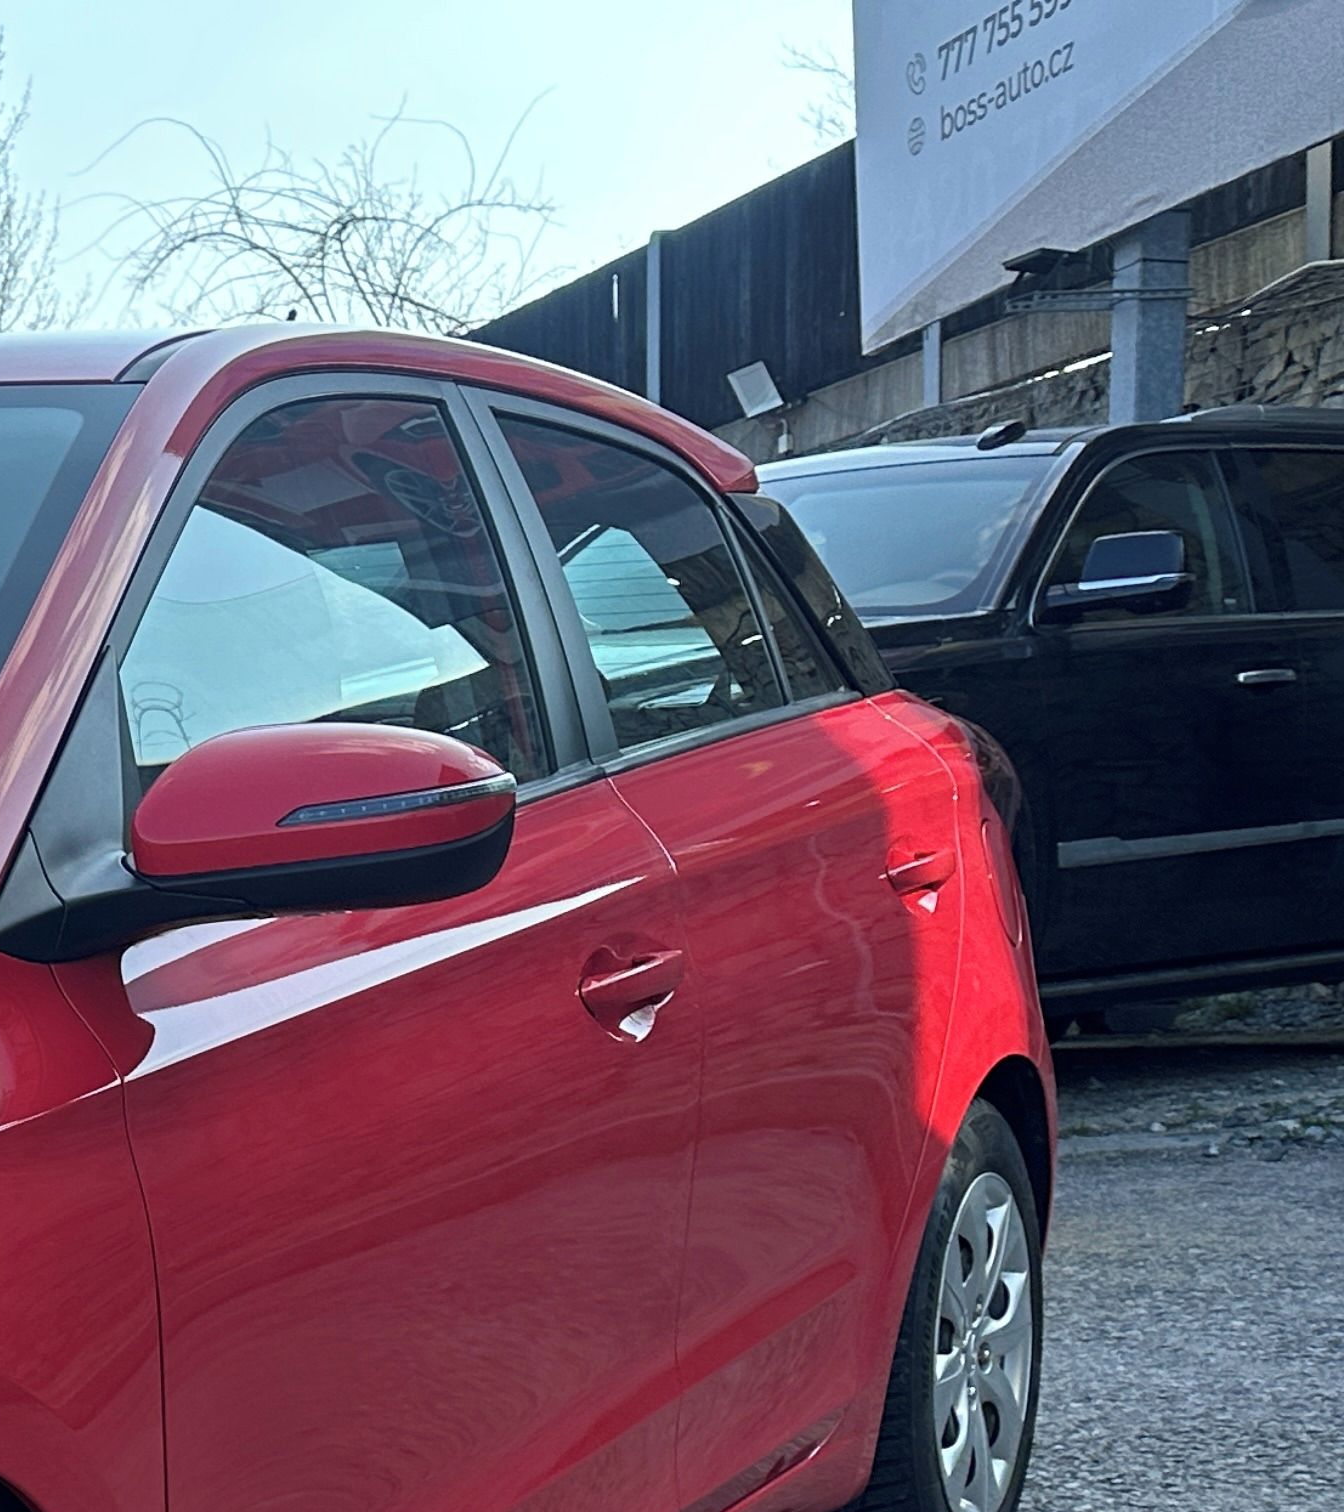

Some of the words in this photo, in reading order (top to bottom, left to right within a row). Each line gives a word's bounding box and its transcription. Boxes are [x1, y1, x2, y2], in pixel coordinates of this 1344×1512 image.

[937, 25, 978, 81] 777
[983, 0, 1024, 55] 755
[940, 41, 1074, 141] boss-auto.cz
